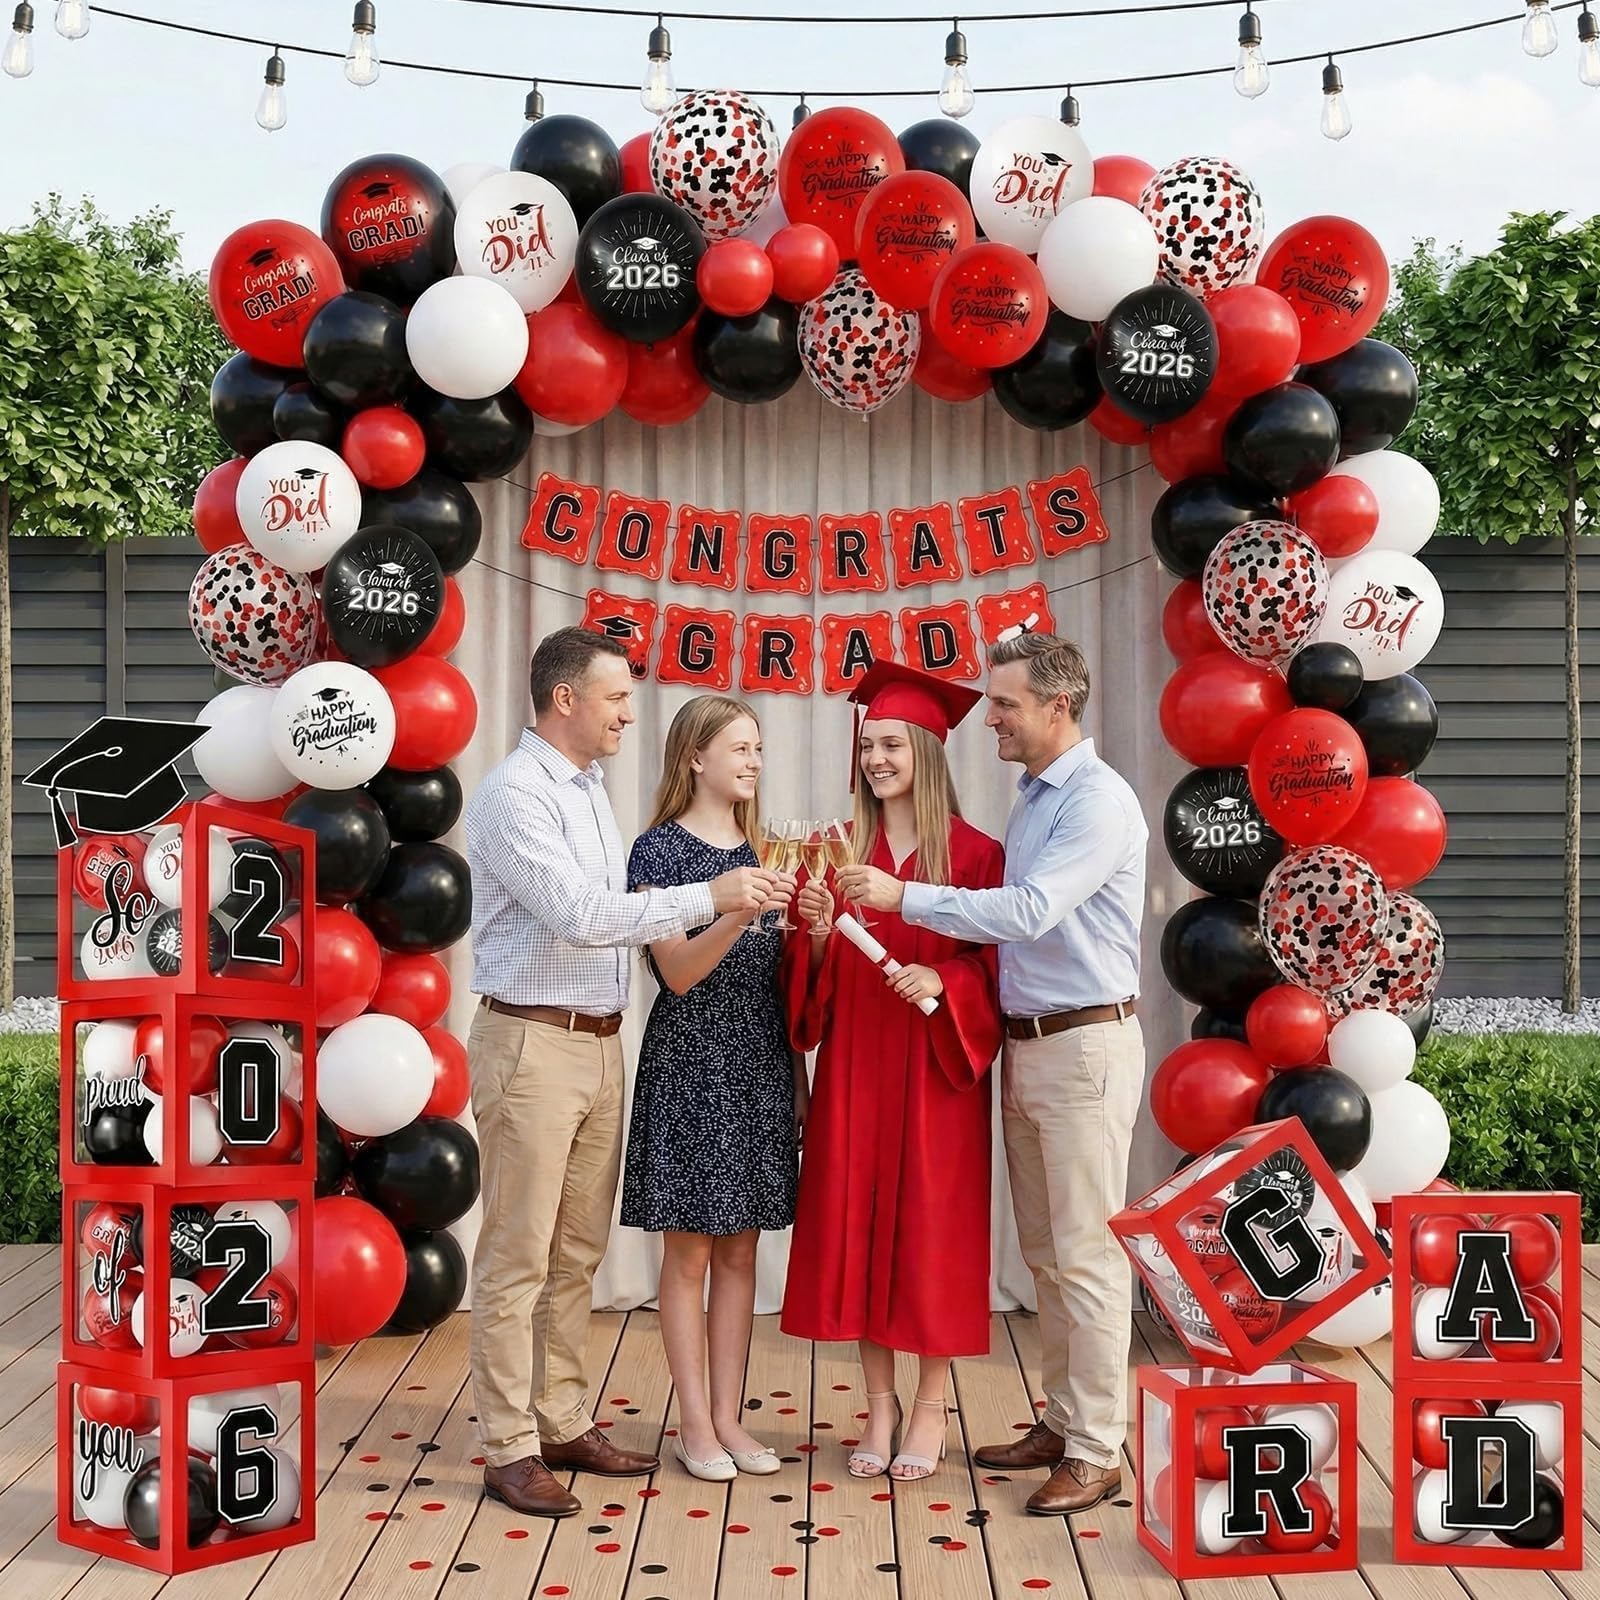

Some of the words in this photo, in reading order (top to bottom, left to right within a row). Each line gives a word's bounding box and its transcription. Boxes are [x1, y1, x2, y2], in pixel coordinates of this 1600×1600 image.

[1013, 153, 1043, 173] YOU
[353, 196, 407, 225] Congrats
[993, 163, 1072, 216] Did
[348, 214, 427, 252] GRAD!
[482, 204, 556, 274] Did
[485, 216, 518, 234] YOU
[244, 259, 296, 294] Congrats
[607, 264, 679, 290] 2026
[613, 246, 650, 265] Class
[243, 271, 318, 320] GRAD!
[1120, 350, 1195, 379] 2026
[260, 473, 331, 531] Did
[269, 478, 300, 494] YOU
[306, 521, 317, 533] IT
[543, 486, 1088, 580] CONGRATS
[348, 586, 420, 616] 2026
[1364, 581, 1394, 605] YOU
[1343, 598, 1424, 651] Did
[678, 620, 960, 680] GRAD
[292, 713, 377, 757] Graduation
[311, 700, 354, 721] HAPPY
[1269, 767, 1355, 801] Graduation
[1291, 753, 1335, 769] HAPPY
[1192, 821, 1261, 850] 2026
[91, 860, 158, 948] So
[230, 852, 284, 965] 2
[84, 1054, 146, 1127] proud
[1221, 1184, 1327, 1303] G
[94, 1228, 126, 1325] of
[201, 1220, 272, 1336] 2
[1436, 1229, 1536, 1344] A
[79, 1418, 144, 1501] you
[217, 1403, 279, 1525] 6
[1222, 1424, 1314, 1538] R
[1439, 1415, 1536, 1531] D
